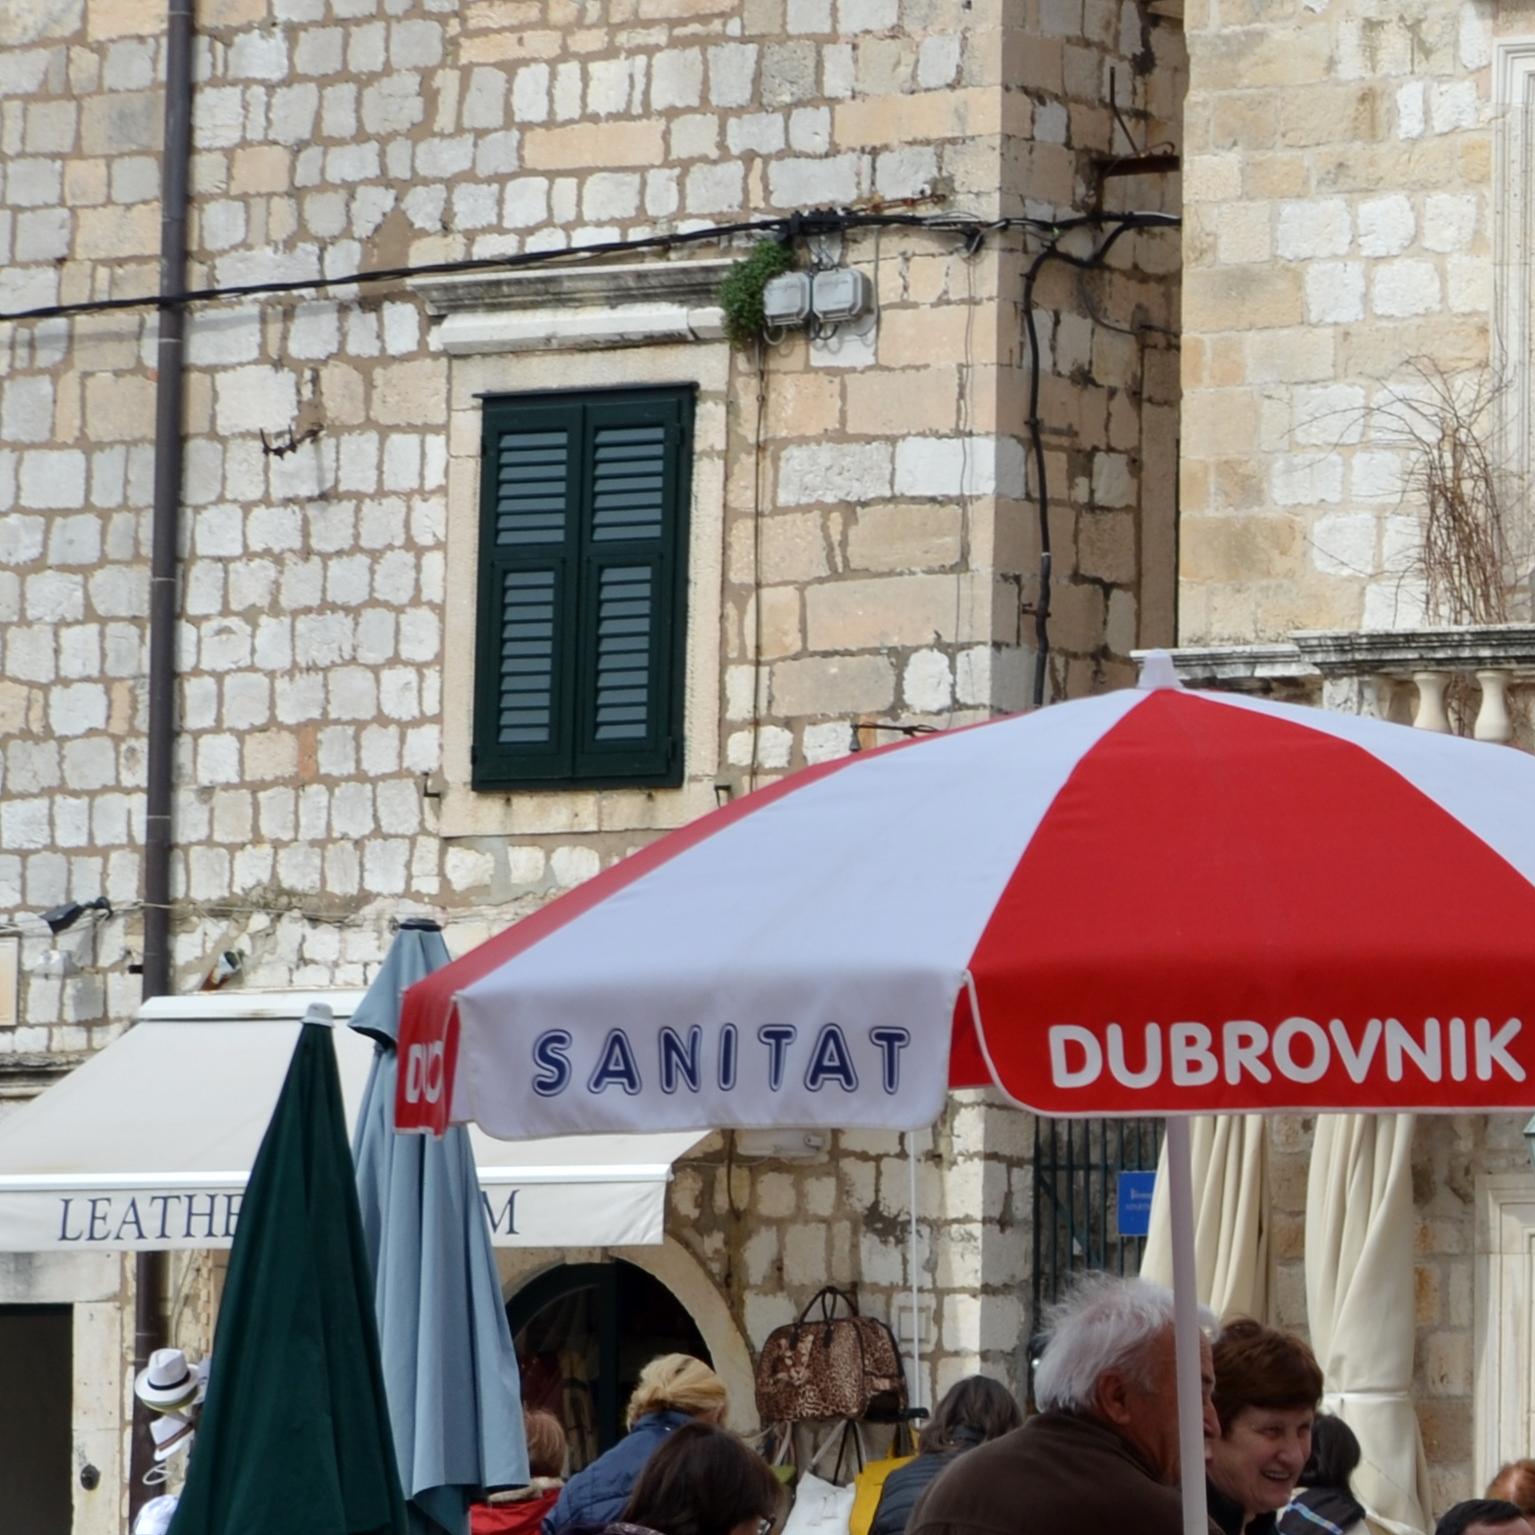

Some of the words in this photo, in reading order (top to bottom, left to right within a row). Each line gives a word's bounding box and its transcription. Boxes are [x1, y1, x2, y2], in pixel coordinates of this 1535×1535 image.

[532, 1023, 911, 1097] SANITAT
[1048, 1017, 1527, 1088] DUBROVNIK
[57, 1193, 244, 1242] LEATHE
